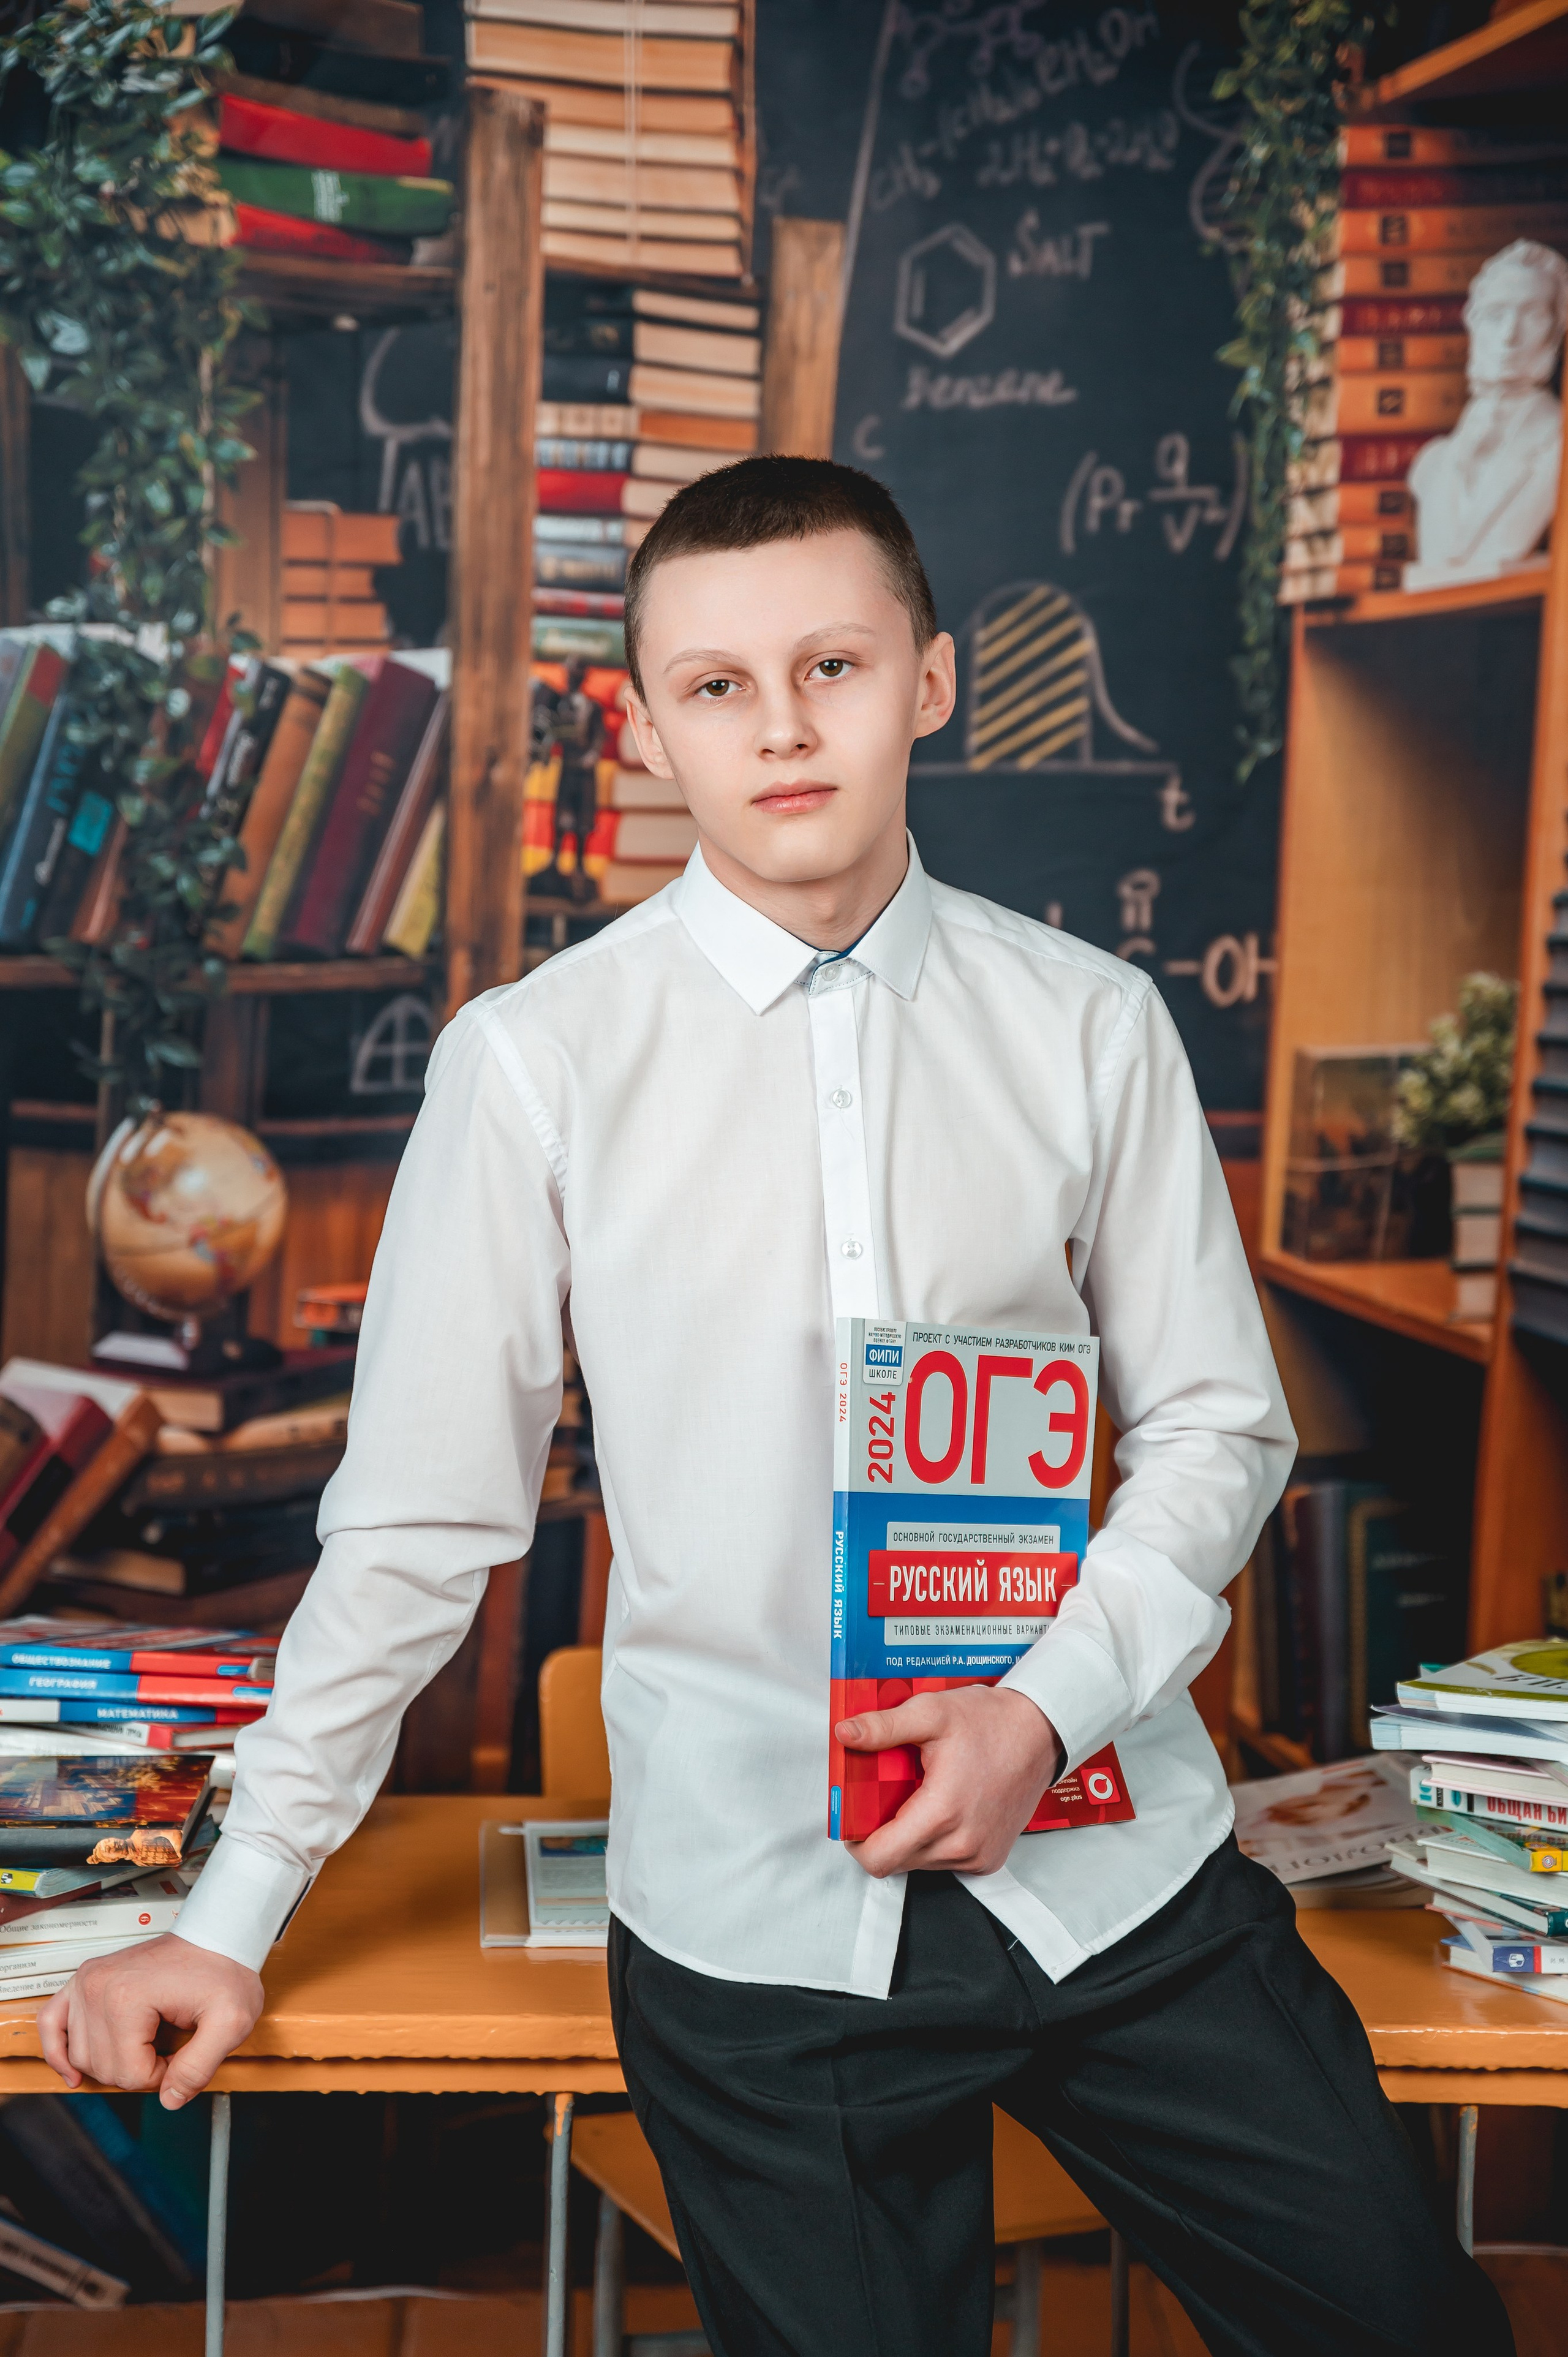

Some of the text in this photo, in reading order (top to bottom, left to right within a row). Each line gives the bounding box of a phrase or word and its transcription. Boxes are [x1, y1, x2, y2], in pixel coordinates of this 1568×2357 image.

[913, 1332, 1091, 1354] ПРОЕКТ С УЧАСТИЕМ РАЗРАБОТЧИКОВ КИМ ОГЭ
[869, 1348, 899, 1364] ФИПИ
[869, 1368, 897, 1379] ШКОЛЕ
[903, 1350, 1090, 1490] ОГЭ
[867, 1391, 896, 1484] 2024
[893, 1531, 1054, 1545] ОСНОВНОЙ ГОСУДАРСТВЕННЫЙ ЭКЗАМЕН
[834, 1531, 844, 1639] РУССКИЙ ЯЗЫК
[889, 1559, 1057, 1602] РУССКИЙ ЯЗЫК
[894, 1624, 1050, 1636] ТИПОВЫЕ ЭКЗАМЕНАЦИОННЫЕ ВАРИАНТ
[12, 1653, 111, 1669] ОБЩЕСТВОЗНАНИЕ
[886, 1657, 903, 1667] ПОД
[906, 1655, 951, 1667] РЕДАКЦИЕЙ
[952, 1656, 965, 1665] Р.А.
[967, 1656, 1014, 1667] ДОЩИНСКОГО,
[29, 1676, 98, 1690] ГЕОГРАФИЯ
[97, 1708, 179, 1719] МАТЕМАТИКА
[0, 1920, 98, 1933] Общие закономерности
